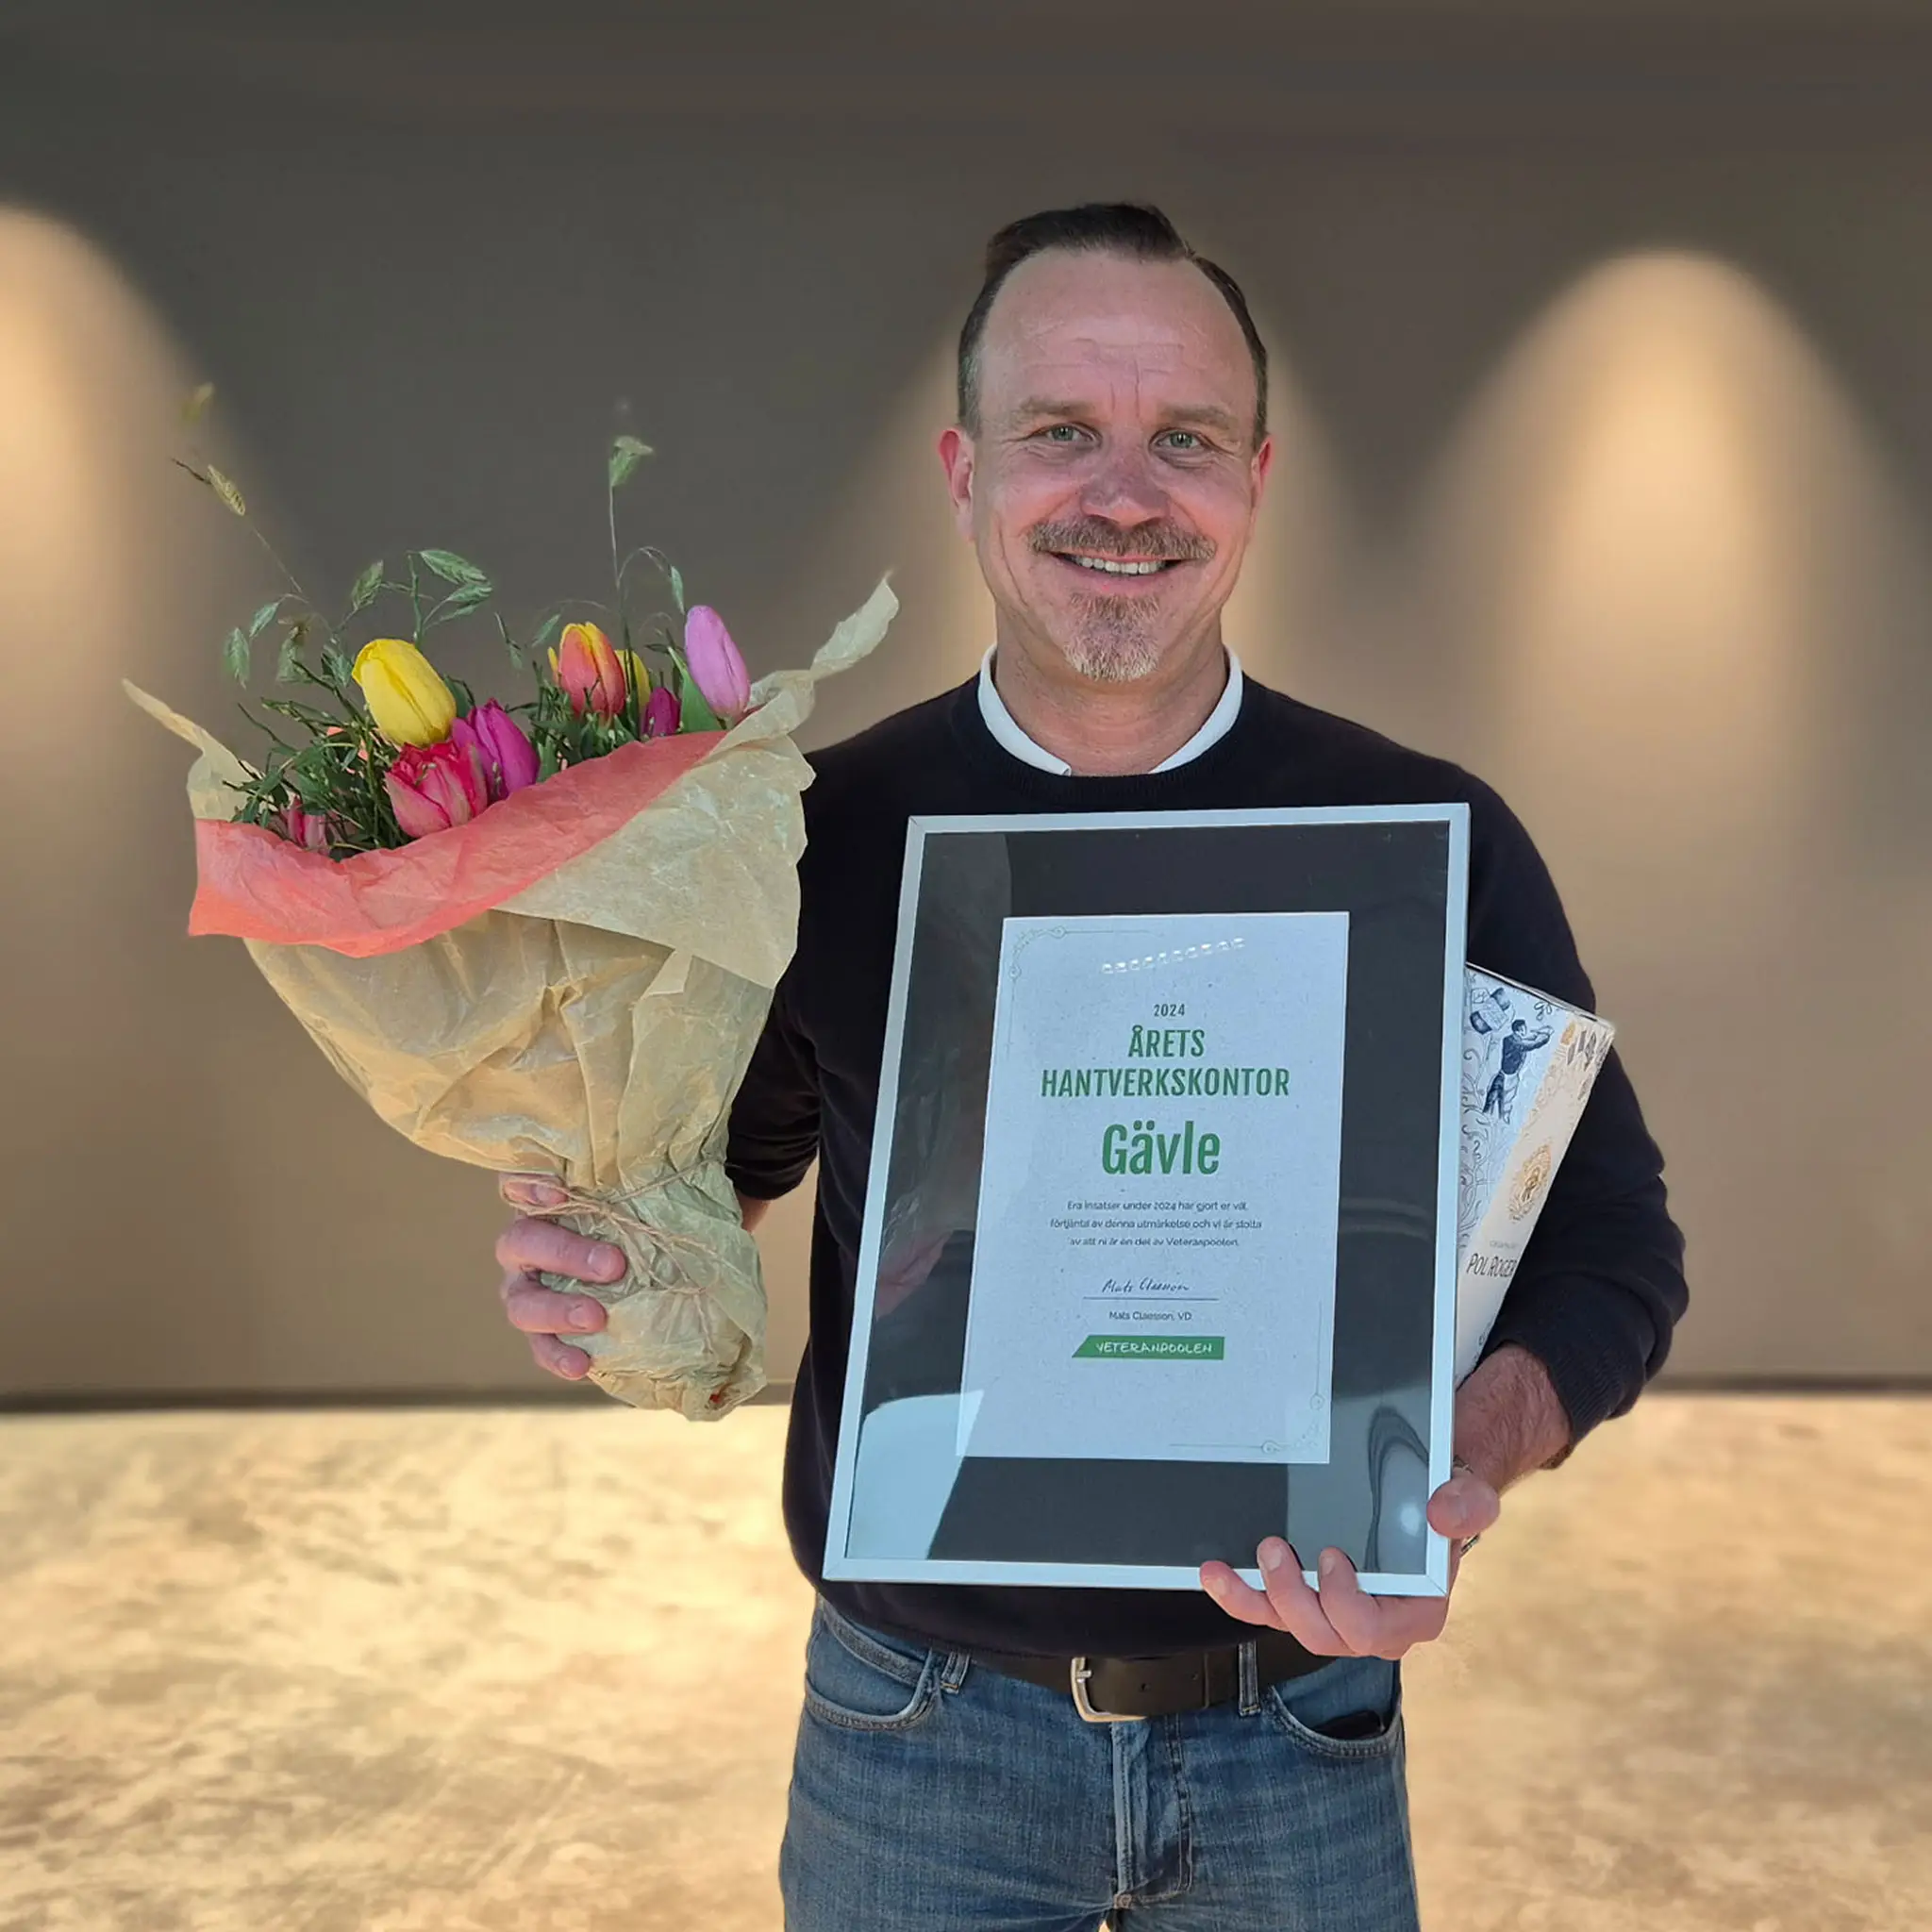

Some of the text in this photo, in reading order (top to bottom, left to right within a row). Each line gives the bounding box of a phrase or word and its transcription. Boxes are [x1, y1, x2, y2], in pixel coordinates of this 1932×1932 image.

[1154, 1004, 1185, 1017] 2024
[1128, 1024, 1205, 1058] ÅRETS
[1041, 1068, 1290, 1097] HANTVERKSKONTOR
[1102, 1120, 1220, 1174] Gävle
[1123, 1201, 1152, 1210] under
[1153, 1201, 1175, 1210] 2024
[1178, 1201, 1193, 1209] har
[1196, 1201, 1218, 1212] gjort
[1105, 1218, 1135, 1227] denna
[1137, 1218, 1191, 1228] utmärkelse
[1192, 1218, 1210, 1228] och
[1212, 1219, 1221, 1228] vi
[1223, 1219, 1233, 1228] är
[1235, 1219, 1262, 1228] stolta
[1135, 1238, 1151, 1246] del
[1466, 1253, 1489, 1276] POL
[1109, 1311, 1130, 1321] Mats
[1178, 1311, 1192, 1321] VD
[1096, 1341, 1212, 1355] VETERANPOOLEN
